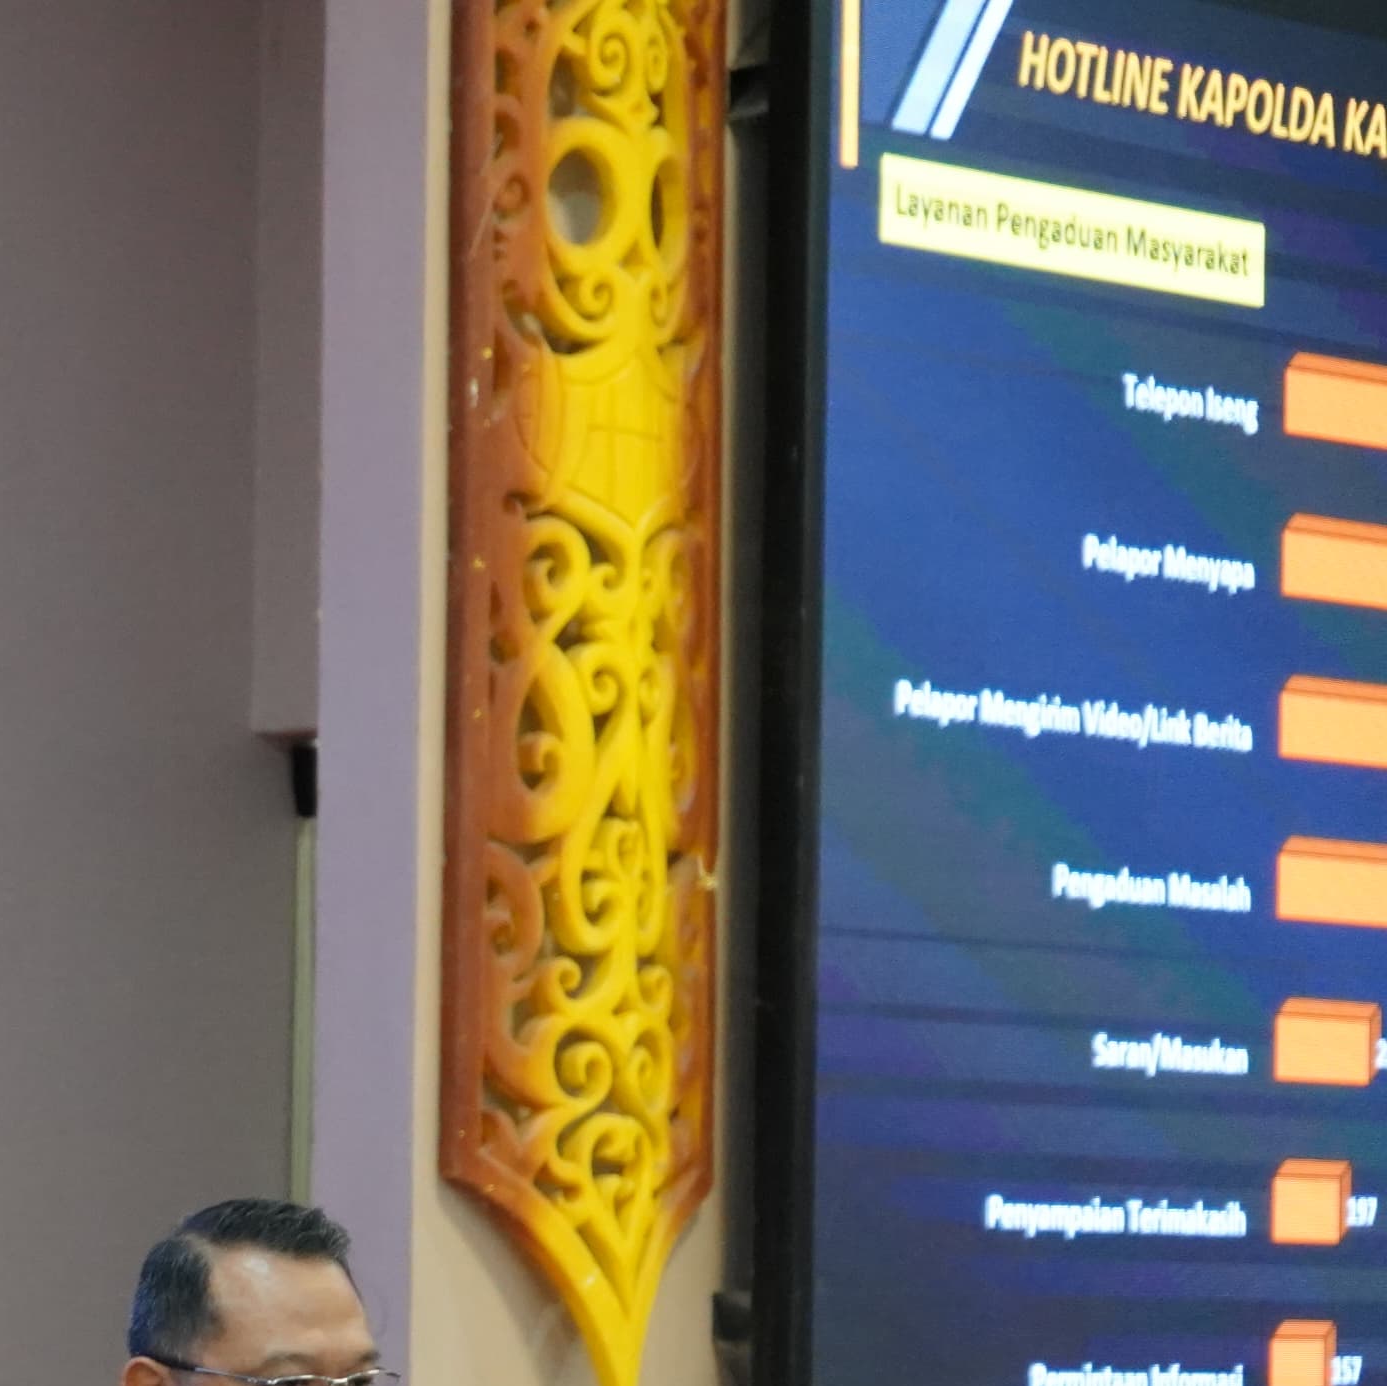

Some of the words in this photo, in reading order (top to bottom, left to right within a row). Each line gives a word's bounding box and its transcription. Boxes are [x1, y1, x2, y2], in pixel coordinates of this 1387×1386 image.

[1018, 30, 1173, 116] HOTLINE
[1178, 62, 1336, 149] KAPOLDA
[895, 183, 988, 230] Layanan
[997, 202, 1119, 251] Pengaduan
[1127, 226, 1250, 278] Masyarakat
[1122, 372, 1204, 421] Telepon
[1082, 532, 1162, 583] Pelapor
[1163, 543, 1256, 595] Menyapa
[894, 679, 977, 728] Pelapor
[979, 688, 1081, 738] Mengirim
[1193, 712, 1253, 752] Berita
[1052, 862, 1166, 909] Pengaduan
[1167, 872, 1252, 913] Masalah
[985, 1195, 1125, 1240] Penyampaian
[1127, 1198, 1247, 1237] Terimakasih
